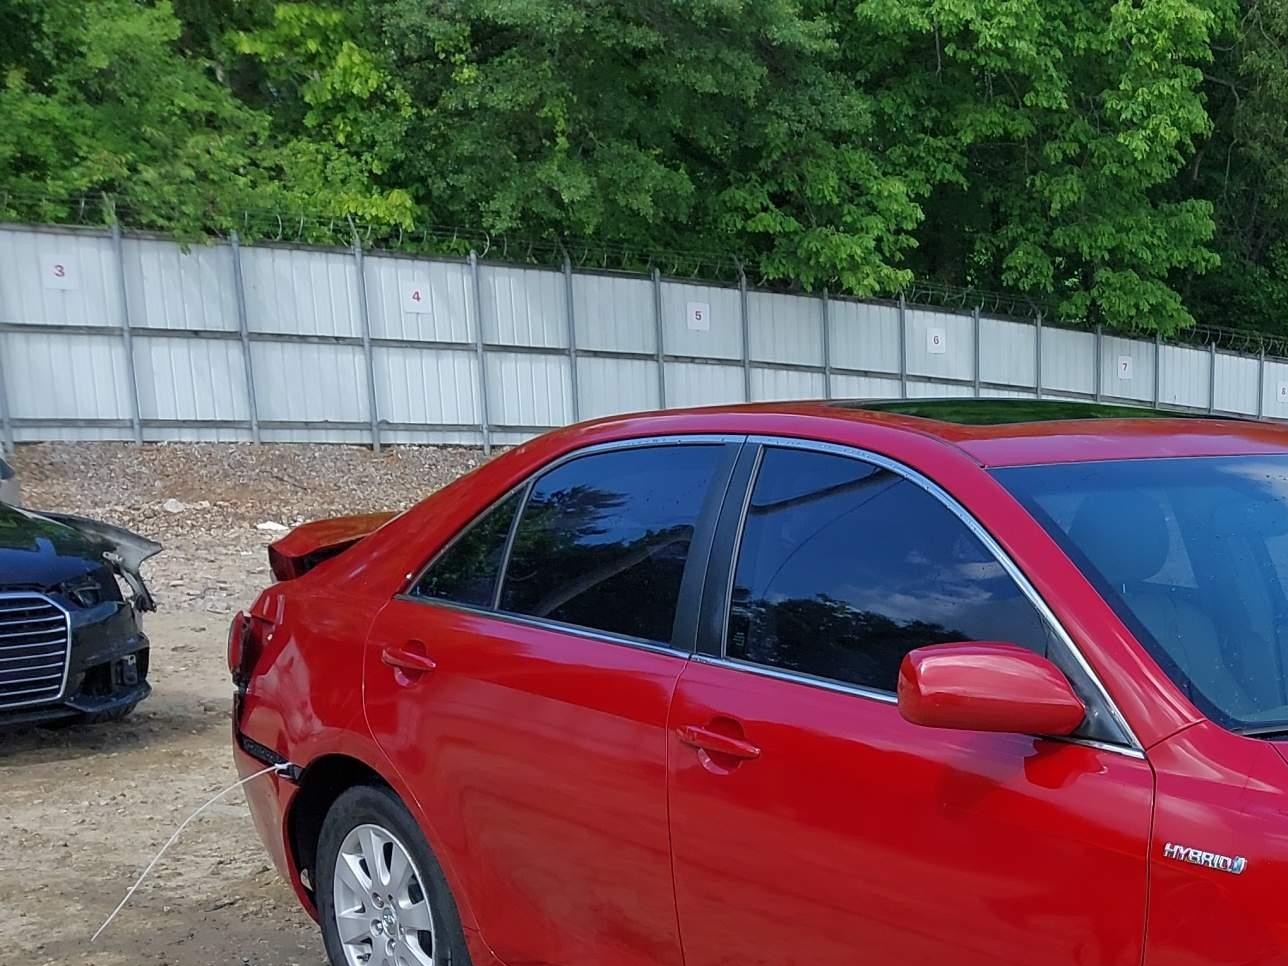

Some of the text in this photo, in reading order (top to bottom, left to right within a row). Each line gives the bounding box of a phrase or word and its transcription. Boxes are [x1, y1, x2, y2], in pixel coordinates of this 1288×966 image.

[54, 264, 65, 277] 3
[412, 291, 421, 302] 4
[695, 310, 702, 321] 5
[933, 335, 940, 345] 6
[1123, 362, 1128, 371] 7
[1163, 842, 1232, 872] HYBRID
